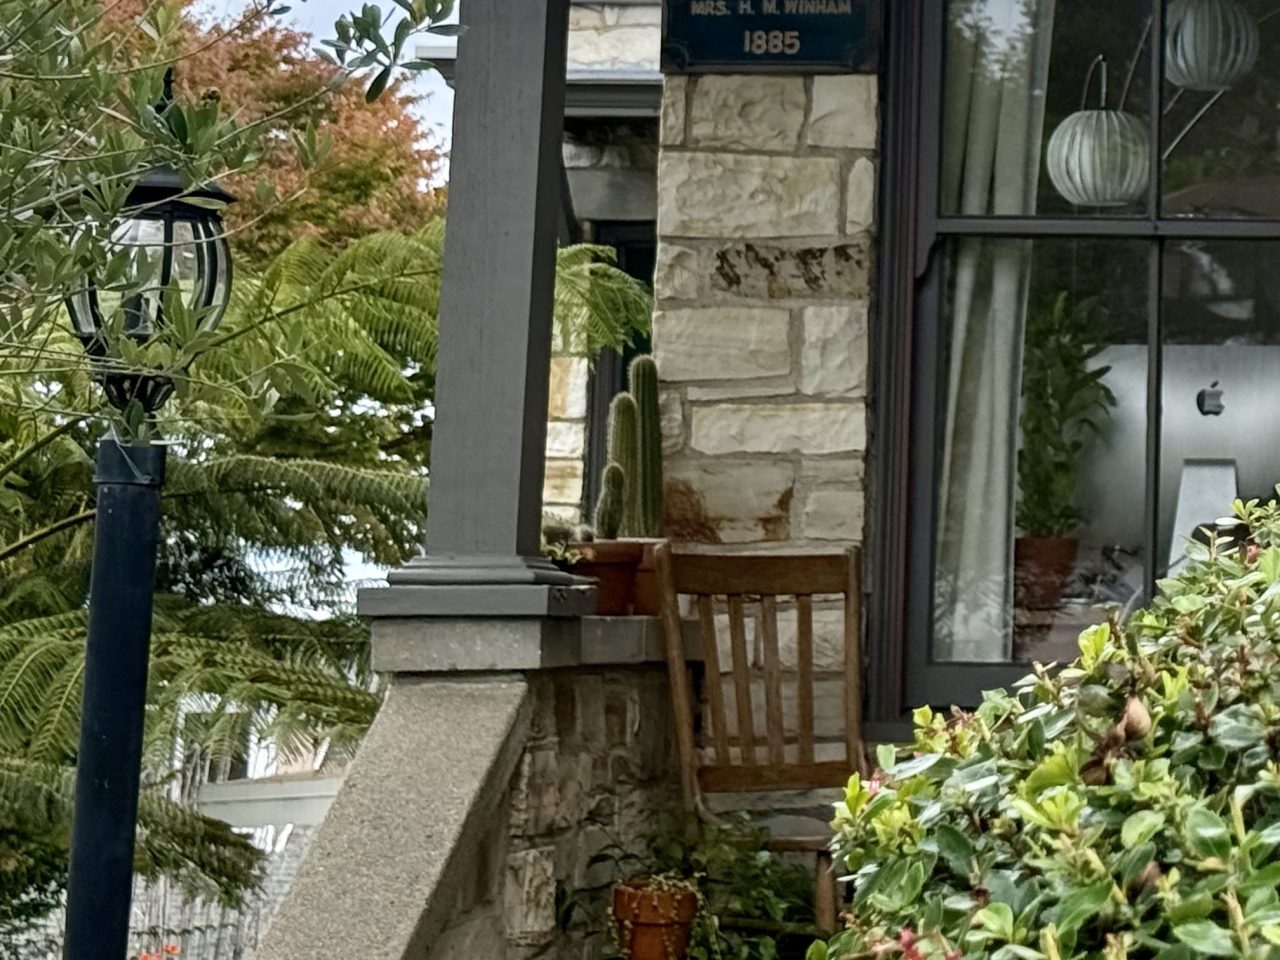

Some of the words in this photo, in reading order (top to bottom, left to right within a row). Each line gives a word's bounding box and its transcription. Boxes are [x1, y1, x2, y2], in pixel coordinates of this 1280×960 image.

[690, 0, 731, 16] MRS.
[738, 0, 755, 15] H.
[743, 30, 801, 55] 1885
